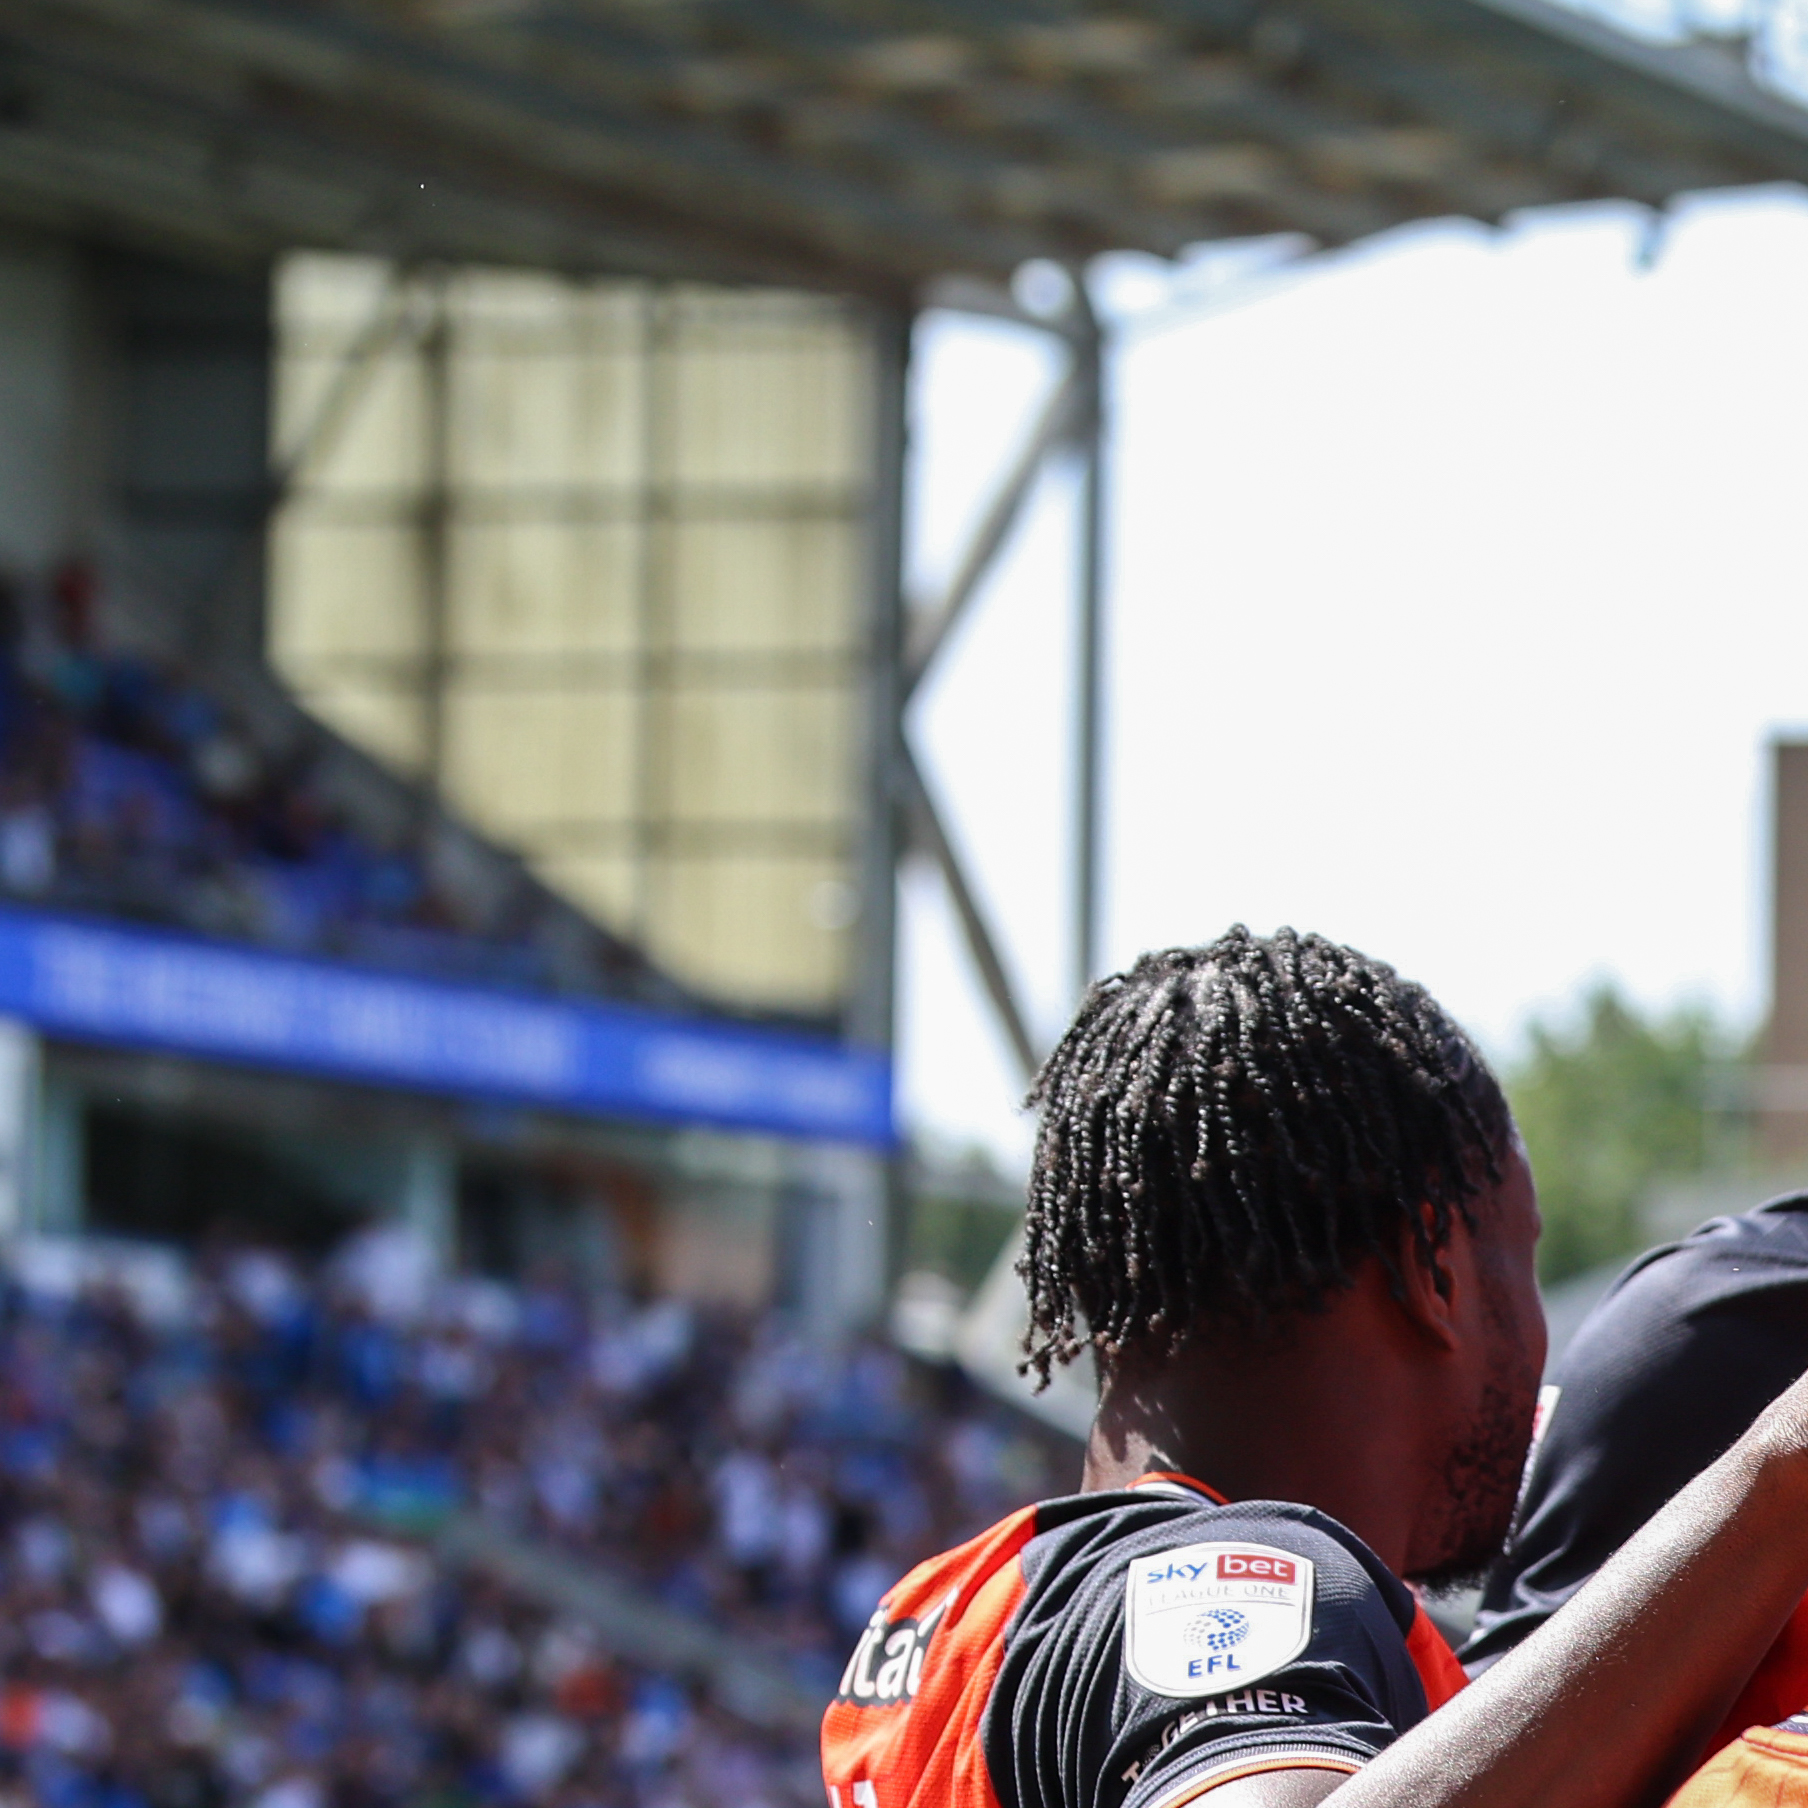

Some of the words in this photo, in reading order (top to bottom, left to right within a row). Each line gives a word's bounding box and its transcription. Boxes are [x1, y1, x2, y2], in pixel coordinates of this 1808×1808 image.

[1146, 1561, 1208, 1584] sky
[1224, 1555, 1288, 1577] bet
[1244, 1584, 1291, 1599] ONE
[1188, 1654, 1241, 1679] EFL
